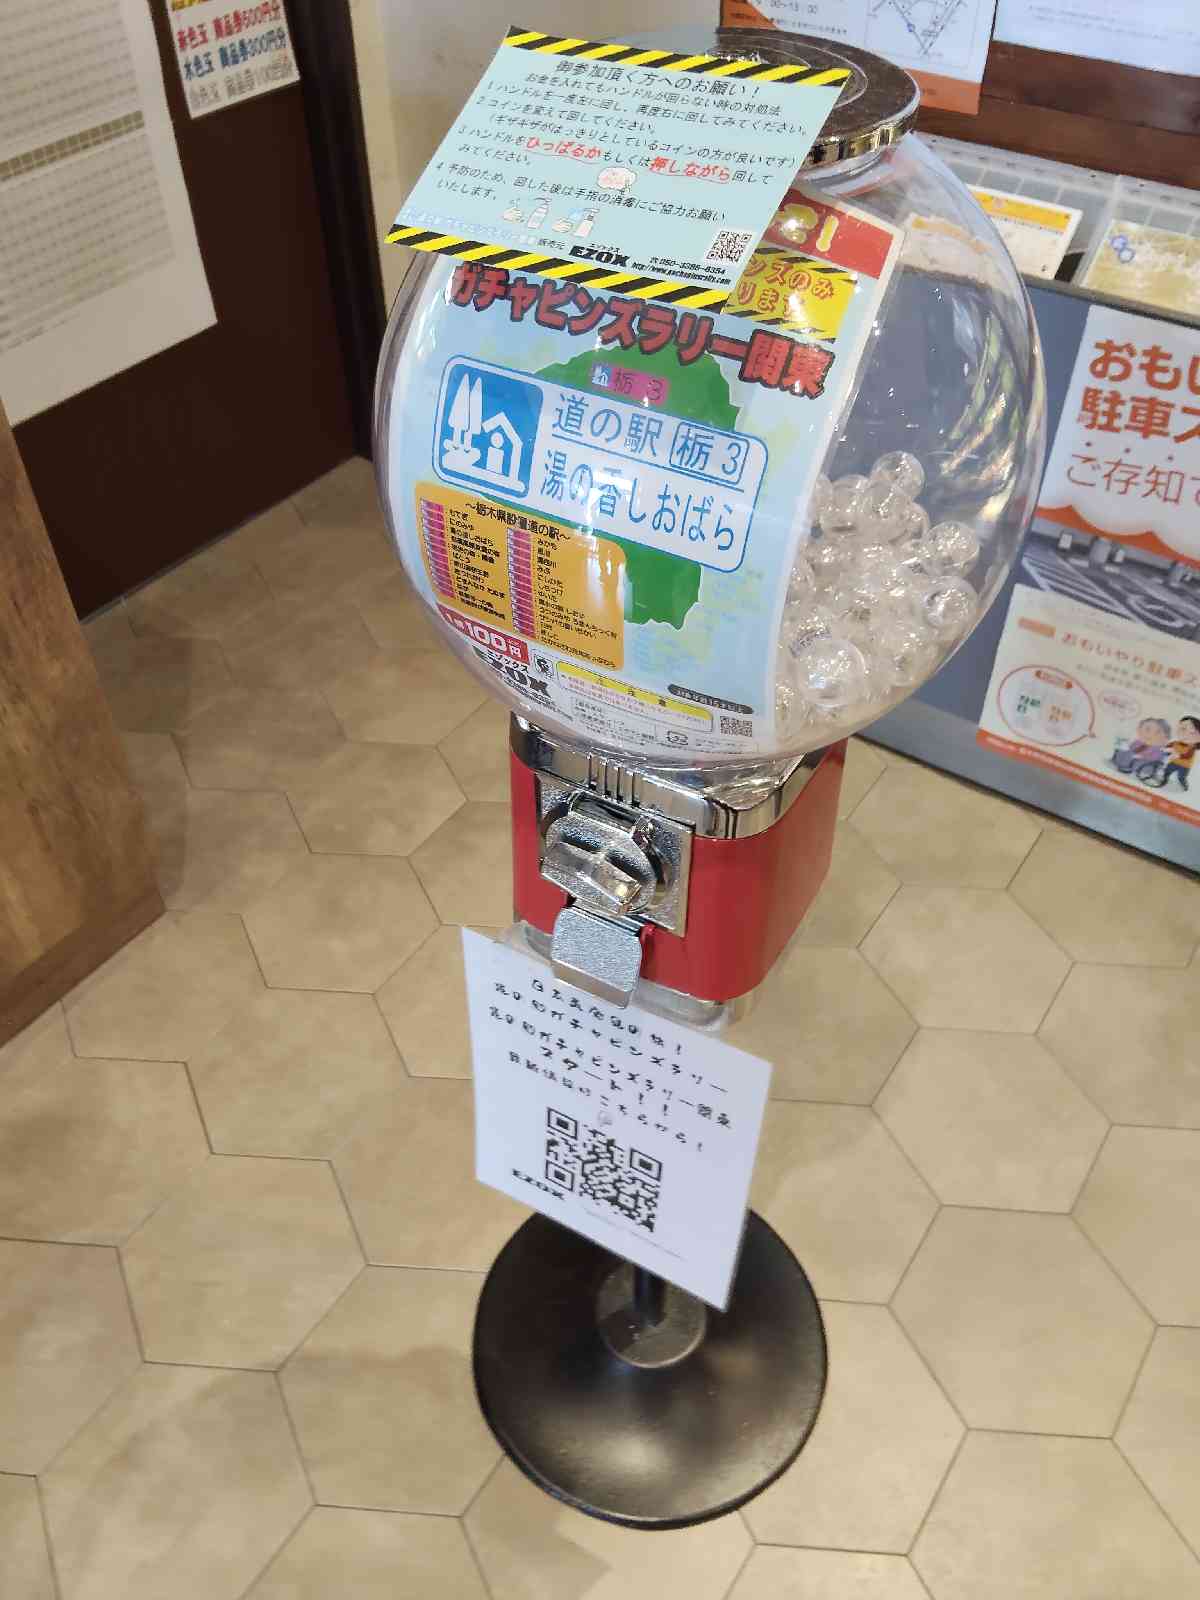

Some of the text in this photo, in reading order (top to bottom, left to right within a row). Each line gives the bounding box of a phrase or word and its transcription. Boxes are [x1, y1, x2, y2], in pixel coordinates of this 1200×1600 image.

[569, 245, 630, 268] EZOX
[452, 260, 835, 399] ガチャピンズラリー関東
[552, 393, 742, 477] 道の駅 栃 3
[1066, 452, 1200, 507] ご存知
